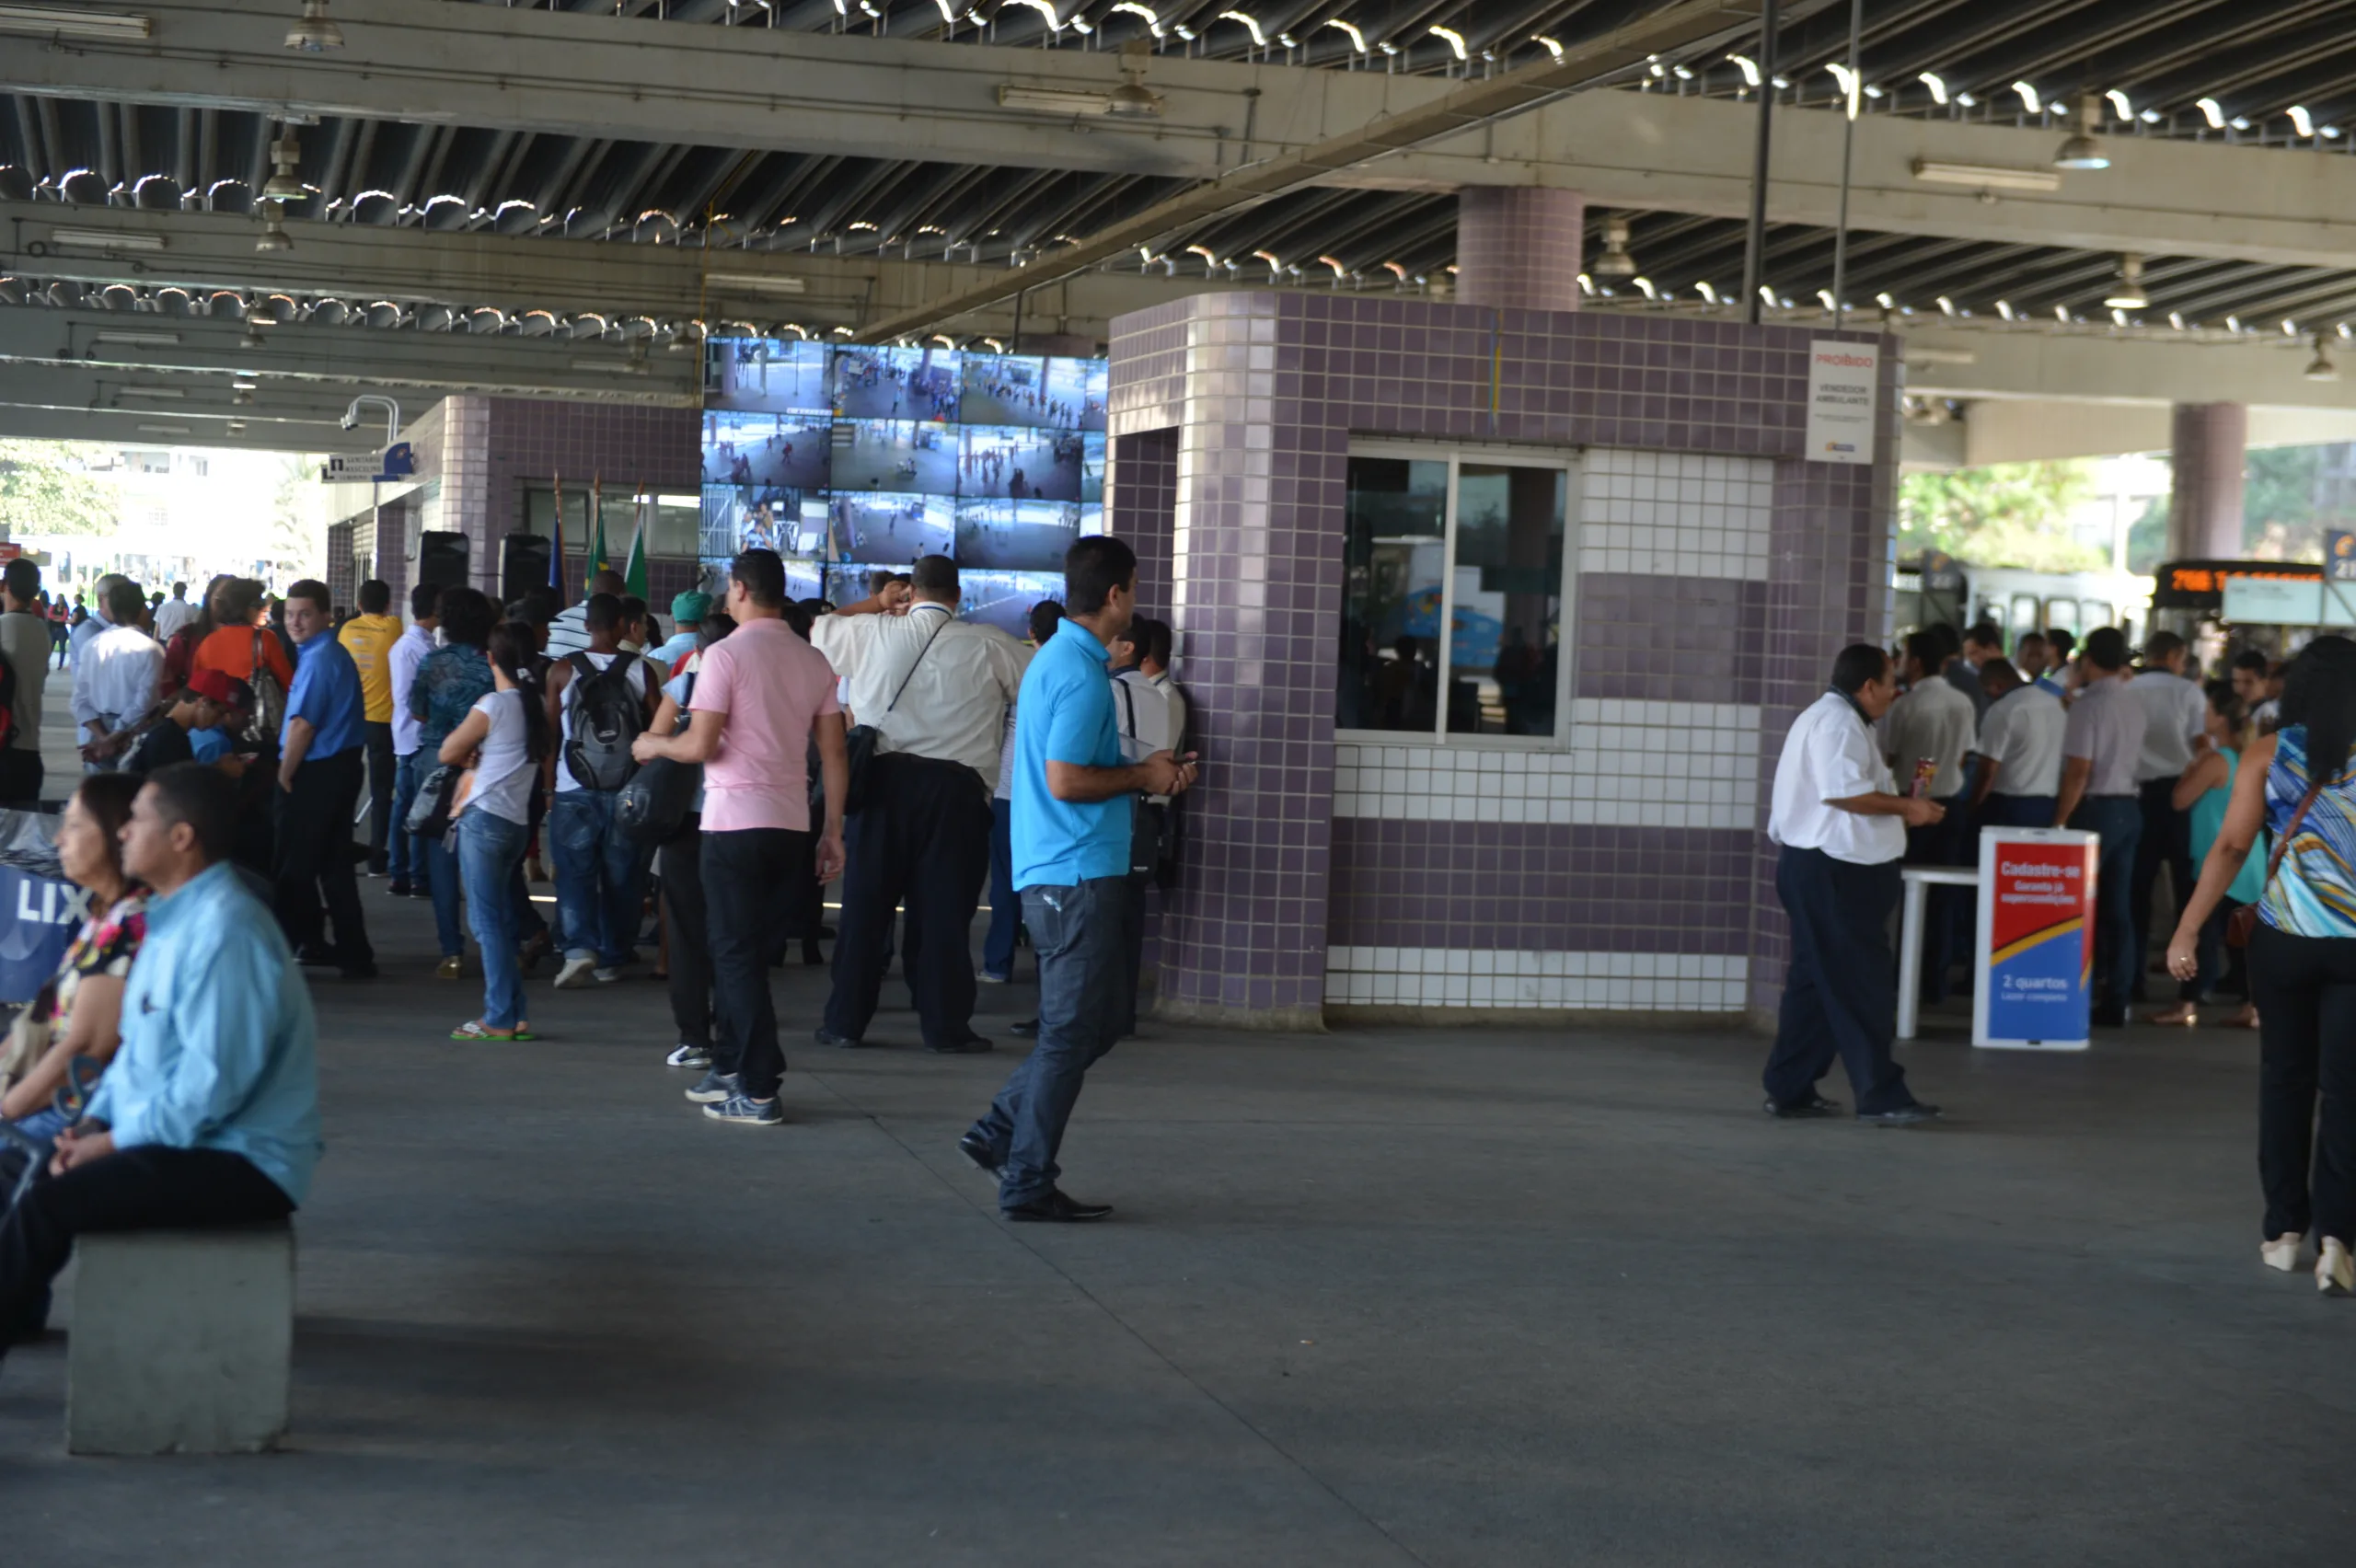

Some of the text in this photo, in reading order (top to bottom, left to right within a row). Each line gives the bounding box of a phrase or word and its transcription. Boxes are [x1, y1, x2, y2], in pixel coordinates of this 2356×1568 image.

[1815, 353, 1874, 368] PROIBIDO
[1819, 384, 1867, 395] VENDEDOR
[1815, 395, 1869, 407] AMBULANTE
[2001, 861, 2081, 878] Cadastre-se
[2002, 974, 2068, 992] 2 quartos
